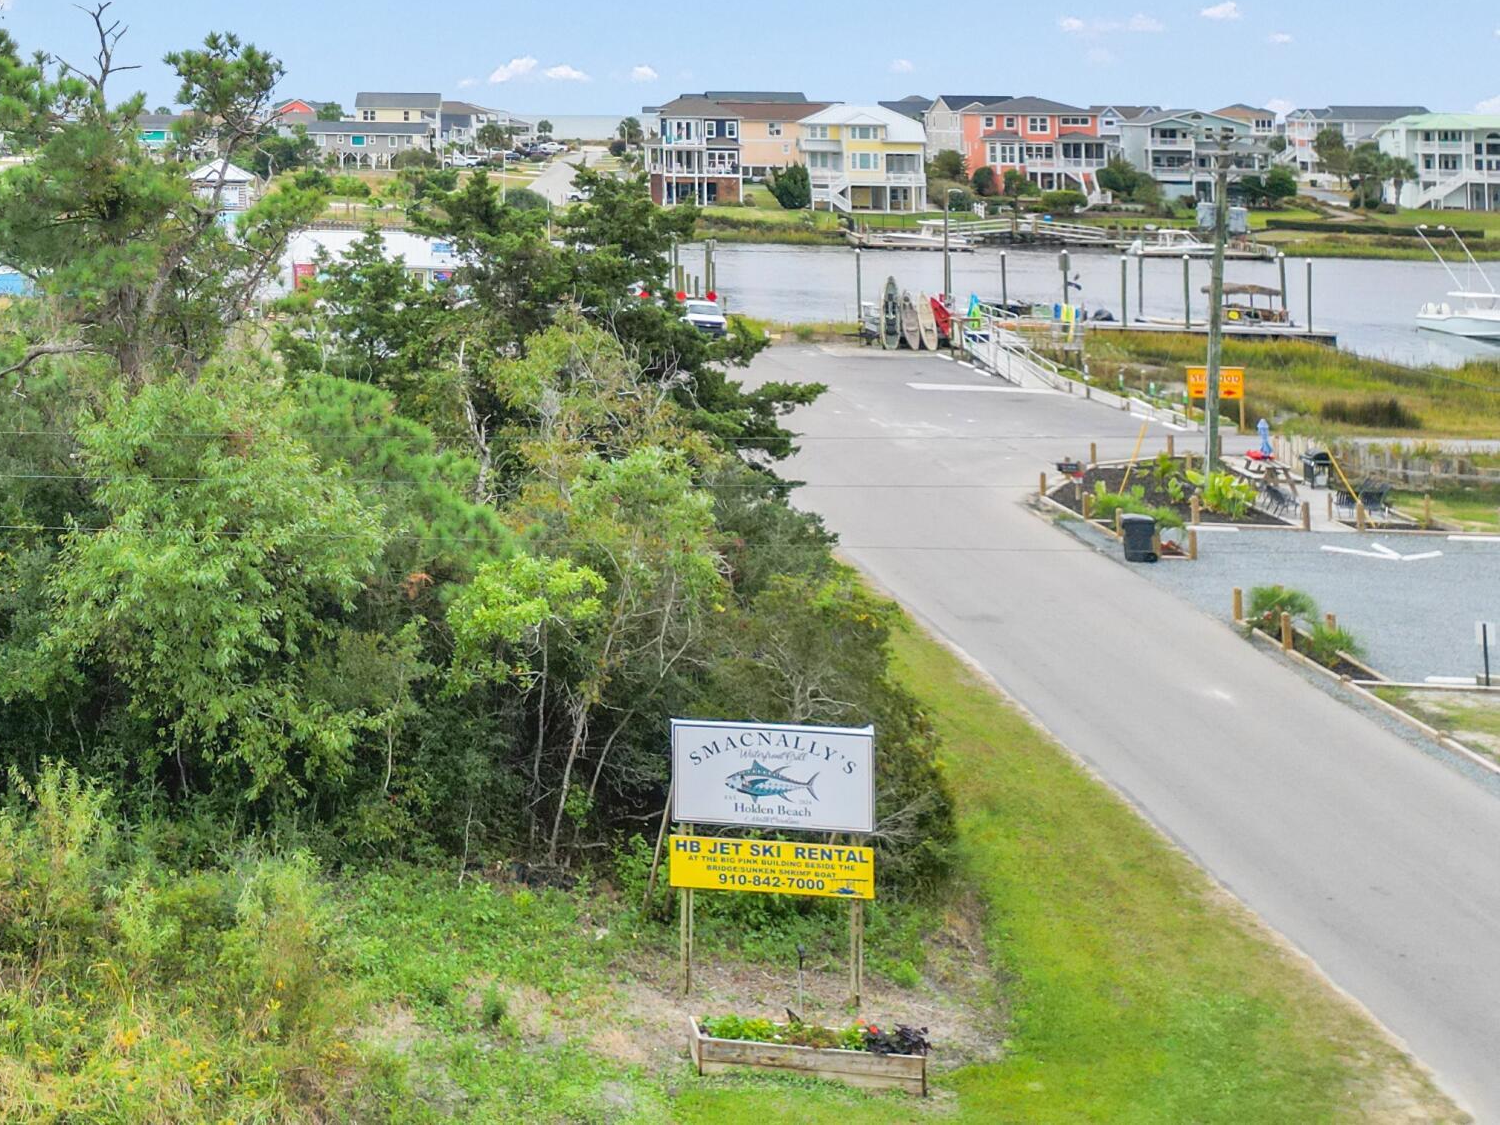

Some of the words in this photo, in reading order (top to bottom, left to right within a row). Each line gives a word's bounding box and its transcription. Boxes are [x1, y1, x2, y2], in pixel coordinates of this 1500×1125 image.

[689, 731, 857, 774] SMACNALLY'S
[734, 802, 774, 815] Holden
[777, 805, 812, 817] Beach
[675, 839, 701, 853] HB
[708, 842, 743, 855] JET
[750, 844, 781, 858] SKI
[794, 847, 869, 863] RENTAL
[761, 859, 802, 868] BUILDING
[719, 873, 825, 890] 910-842-7000
